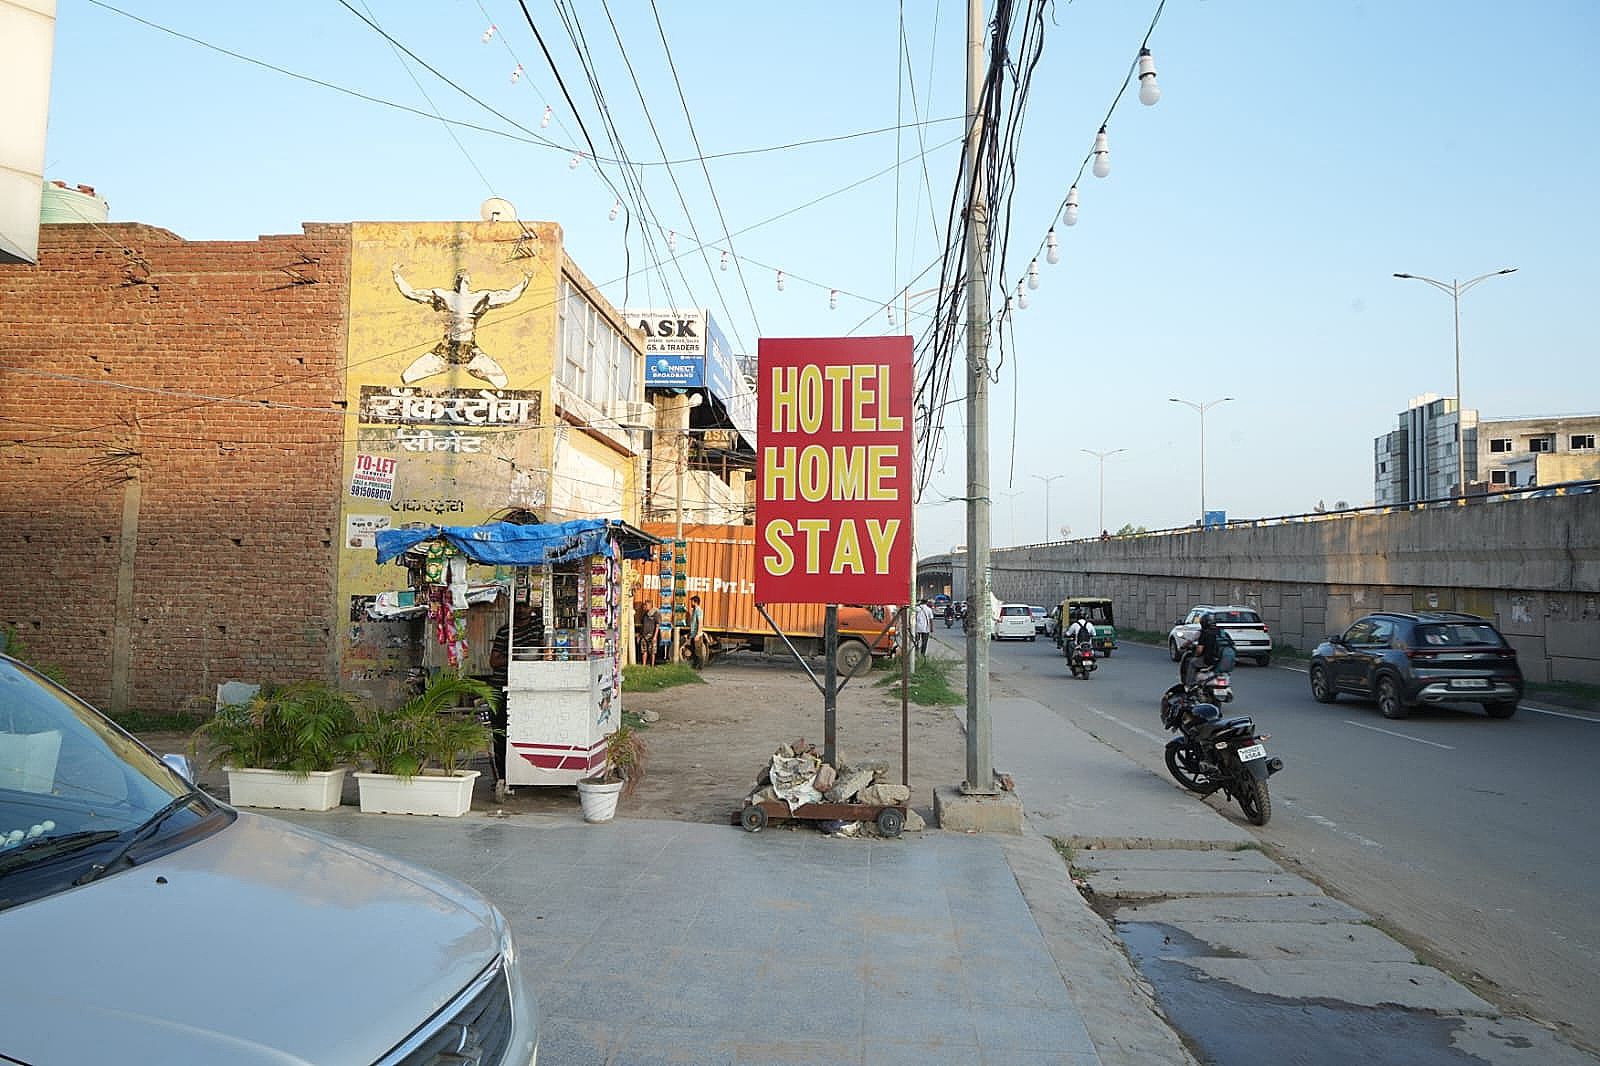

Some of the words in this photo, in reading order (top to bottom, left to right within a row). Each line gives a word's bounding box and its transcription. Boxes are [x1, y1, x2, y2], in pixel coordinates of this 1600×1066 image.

[771, 363, 904, 434] HOTEL
[357, 454, 397, 474] TO-LET
[763, 444, 899, 502] HOME
[763, 518, 901, 576] STAY
